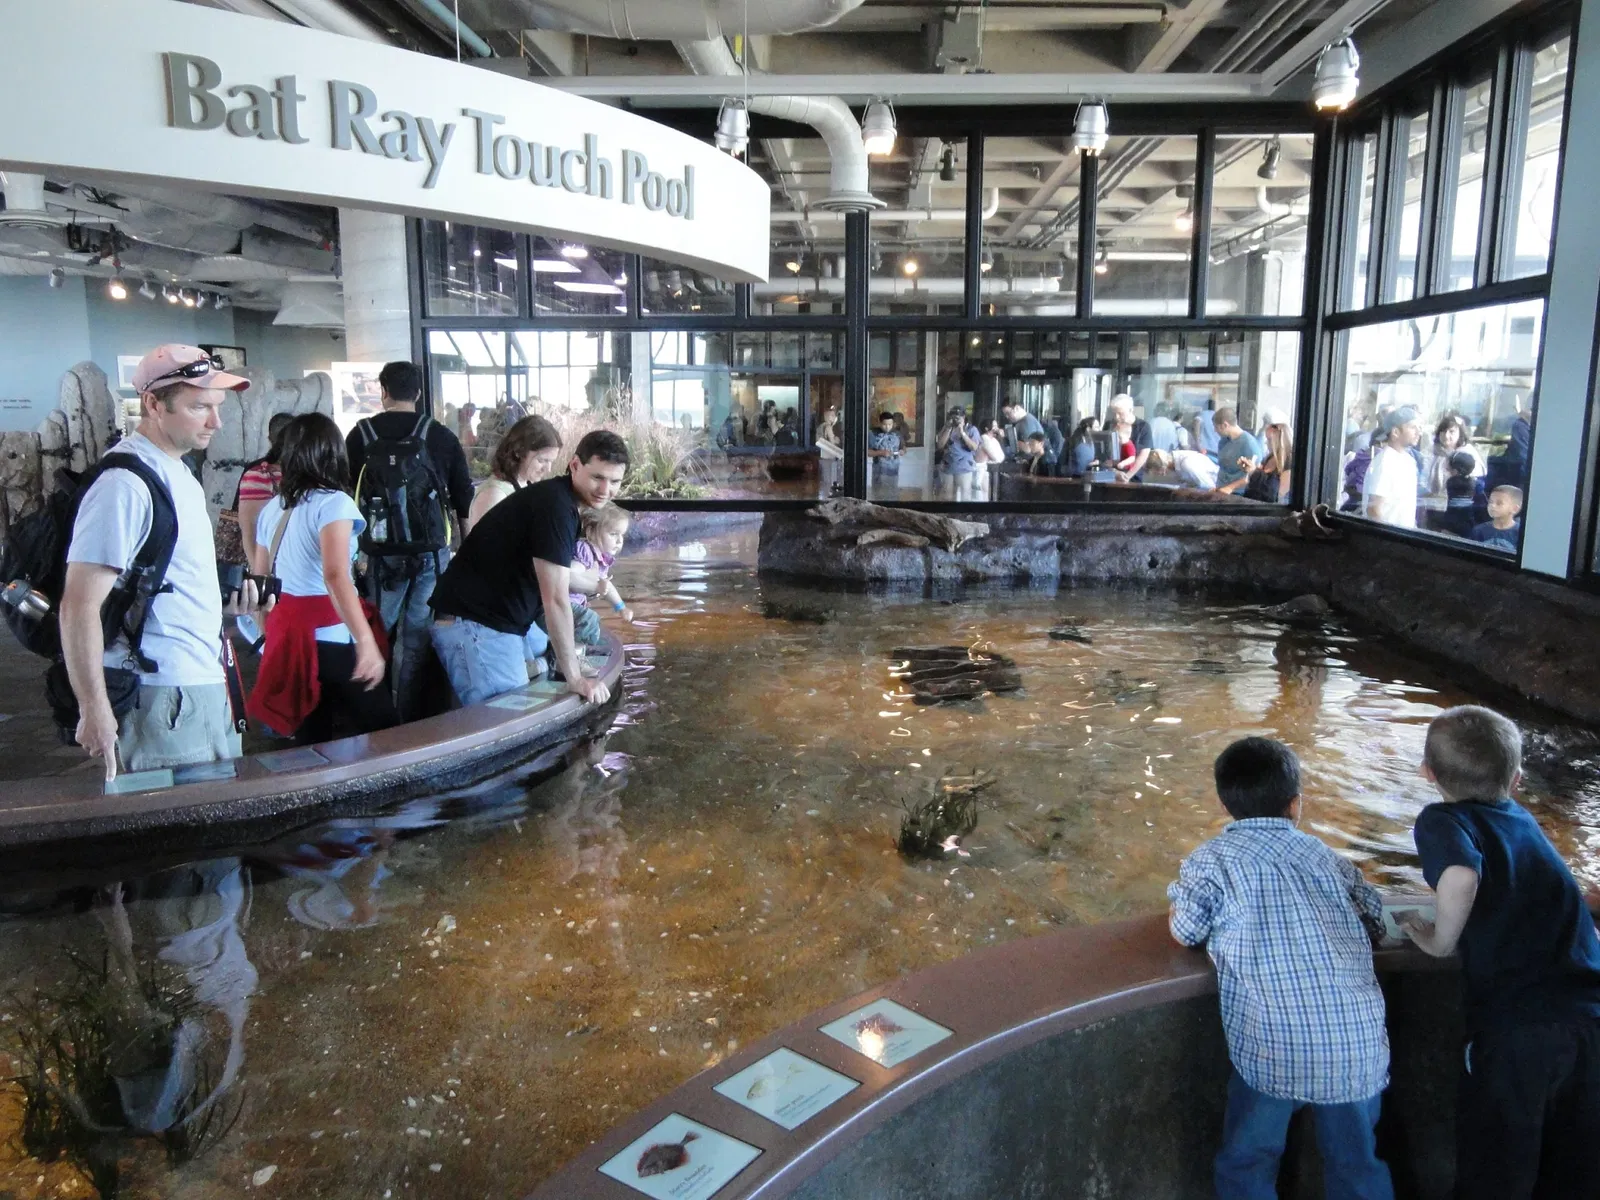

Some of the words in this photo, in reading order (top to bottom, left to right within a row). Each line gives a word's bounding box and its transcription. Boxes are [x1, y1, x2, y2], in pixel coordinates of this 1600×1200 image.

[161, 51, 310, 145] Bat
[327, 79, 457, 189] Ray
[461, 108, 613, 199] Touch
[621, 149, 695, 220] Pool
